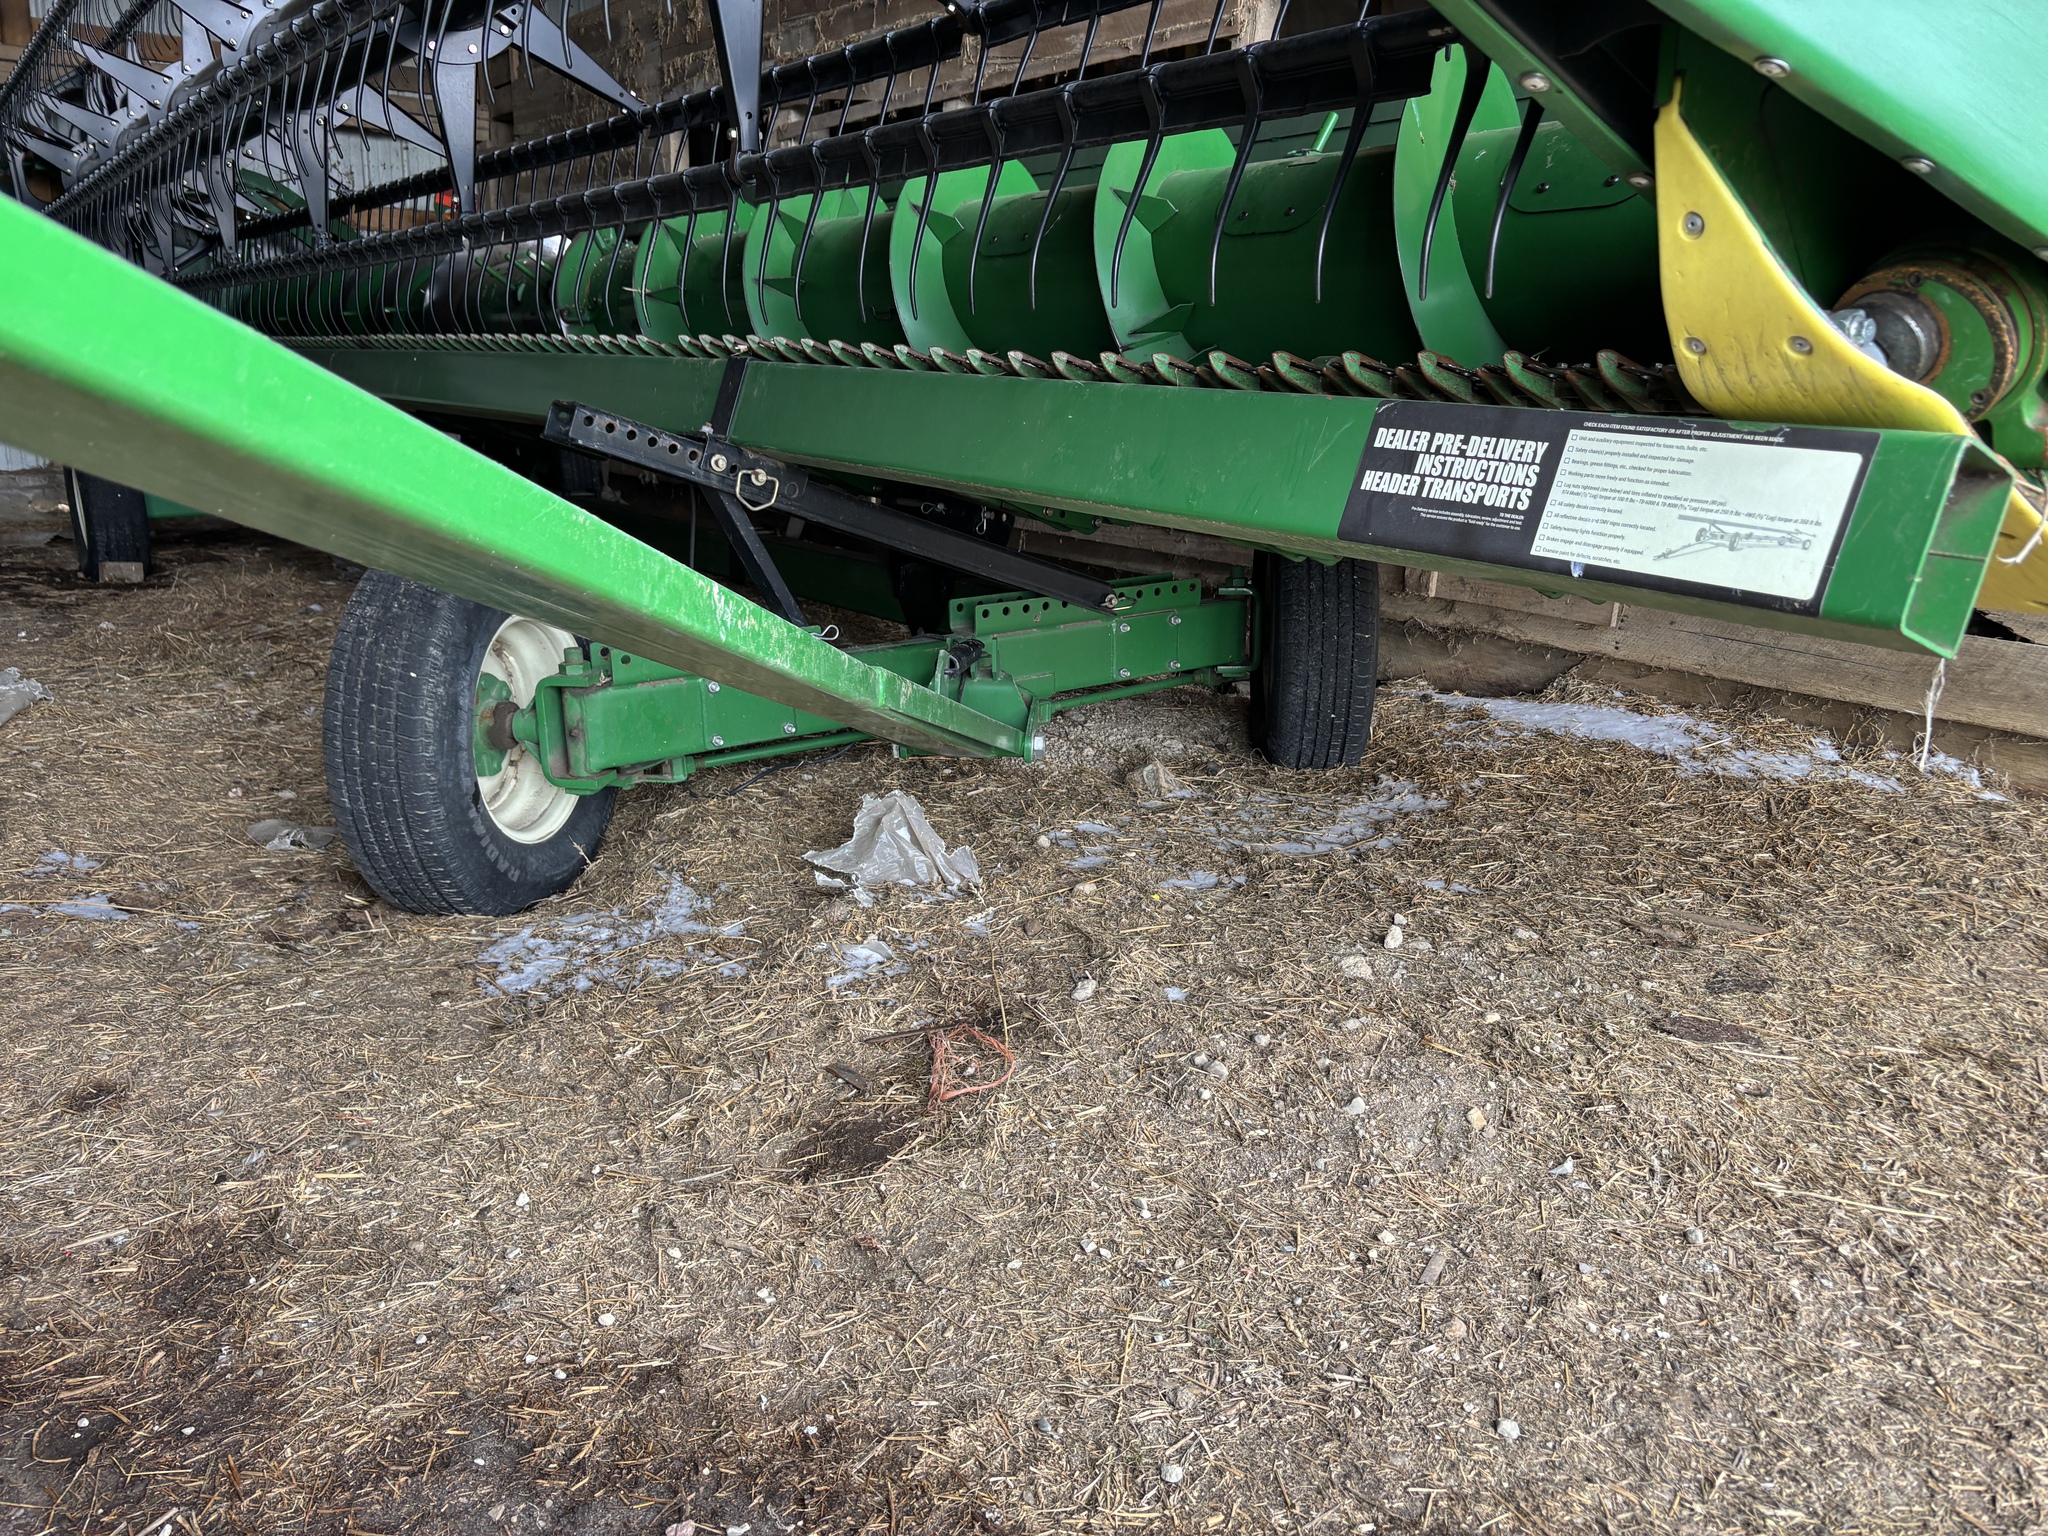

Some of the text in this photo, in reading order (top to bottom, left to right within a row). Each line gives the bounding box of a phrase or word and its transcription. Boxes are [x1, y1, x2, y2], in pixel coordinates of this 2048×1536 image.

[1374, 428, 1549, 463] DEALER PRE-DELIVERY
[1414, 454, 1540, 487] INSTRUCTIONS
[1360, 470, 1532, 511] HEADER TRANSPORTS
[1550, 524, 1578, 534] Safety/warning
[1608, 532, 1625, 540] properly.
[1583, 541, 1602, 549] disengage
[1592, 555, 1612, 563] scratches,
